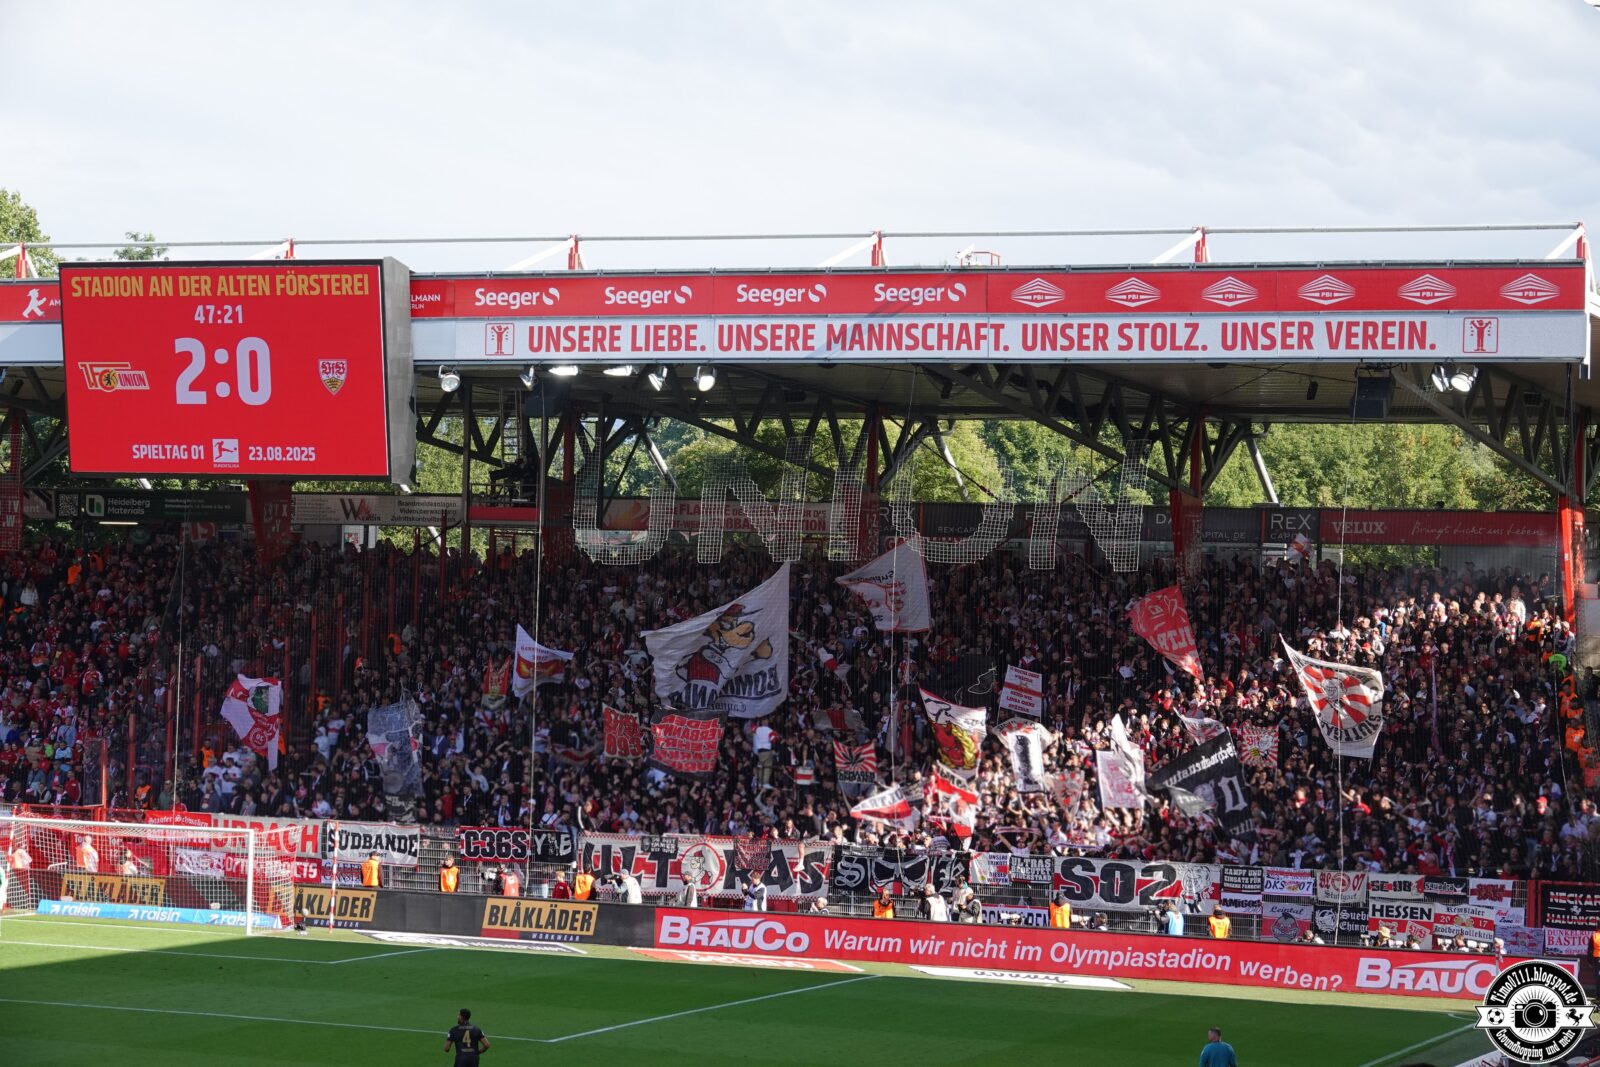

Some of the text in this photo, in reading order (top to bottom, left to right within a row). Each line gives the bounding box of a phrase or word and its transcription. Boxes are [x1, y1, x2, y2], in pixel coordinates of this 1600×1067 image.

[71, 271, 370, 297] STADION AN DER ALTEN FÖRSTEREI
[411, 294, 441, 302] LMANN
[475, 287, 540, 310] Seeger
[605, 286, 671, 309] Seeger
[737, 284, 805, 307] Seeger
[874, 283, 945, 306] Seeger
[194, 305, 244, 324] 47:21
[528, 320, 1436, 353] UNSERE LIEBE. UNSERE MANNSCHAFT. UNSER STOLZ. UNSER VEREIN.
[118, 371, 147, 388] UNION
[174, 336, 272, 406] 2:0
[132, 445, 316, 462] SPIELTAG 01 23.08.2025
[108, 498, 150, 508] Heidelberg
[108, 507, 145, 516] Materials
[680, 504, 731, 516] FLAE
[1270, 513, 1312, 531] REX
[1332, 521, 1385, 535] VELUX
[328, 828, 418, 858] SÜDBANDE
[464, 829, 528, 860] C36S
[1011, 857, 1051, 869] ULTRAS
[1224, 868, 1247, 876] KAMPF
[1248, 869, 1262, 877] UND
[1224, 875, 1262, 884] EINSATZ FÜR
[1265, 880, 1312, 892] DKS 07
[1352, 872, 1366, 892] 07
[1324, 890, 1357, 902] Stuttgart
[61, 904, 101, 918] raisin
[139, 908, 181, 923] raisin
[488, 900, 595, 931] BLÅKLÄDER
[1372, 904, 1432, 921] HESSEN
[313, 919, 360, 929] WORWEAR
[1440, 915, 1488, 928] 20 17
[531, 932, 581, 943] WORKWEAR
[1547, 928, 1593, 937] DUNKELRO
[1547, 936, 1592, 947] BASTIO
[824, 930, 901, 953] Warum
[909, 936, 945, 957] wir
[950, 937, 1008, 961] nicht
[1013, 941, 1042, 963] im
[1049, 941, 1232, 974] Olympiastadion
[1240, 961, 1343, 993] werben?
[1355, 957, 1500, 994] BRAUC
